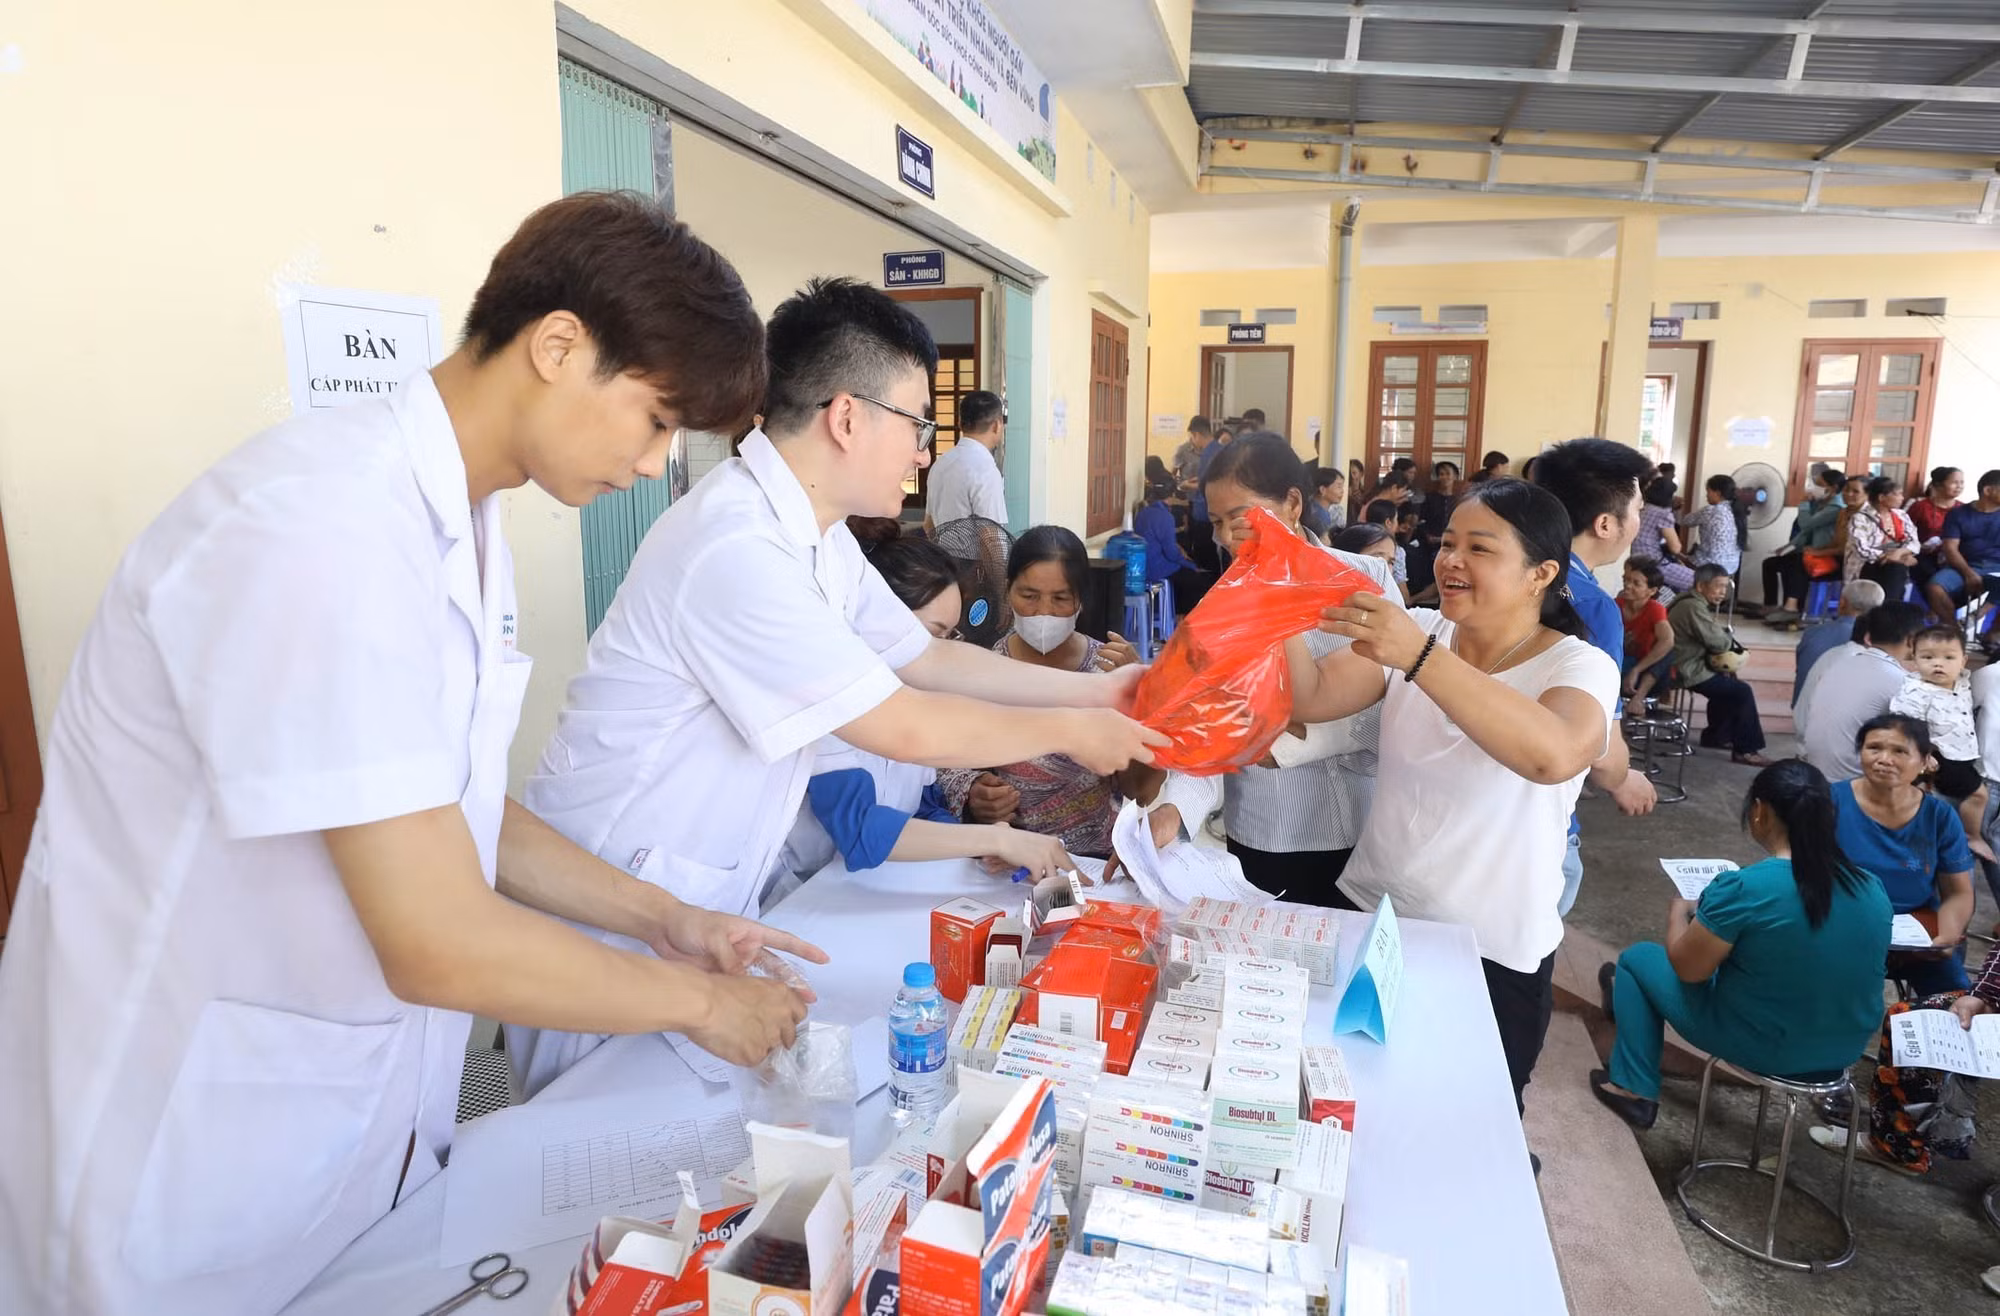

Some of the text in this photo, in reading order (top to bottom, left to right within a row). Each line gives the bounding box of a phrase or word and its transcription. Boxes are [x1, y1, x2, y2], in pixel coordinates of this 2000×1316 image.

[970, 27, 996, 69] NHANH
[901, 255, 926, 265] PHÒNG
[889, 267, 906, 282] SẢN
[344, 329, 397, 360] BÀN
[311, 374, 341, 392] CẤP
[345, 376, 382, 393] PHÁT
[1228, 1106, 1265, 1123] Biosubtyl
[1266, 1111, 1277, 1122] DL
[871, 1284, 901, 1316] Pat
